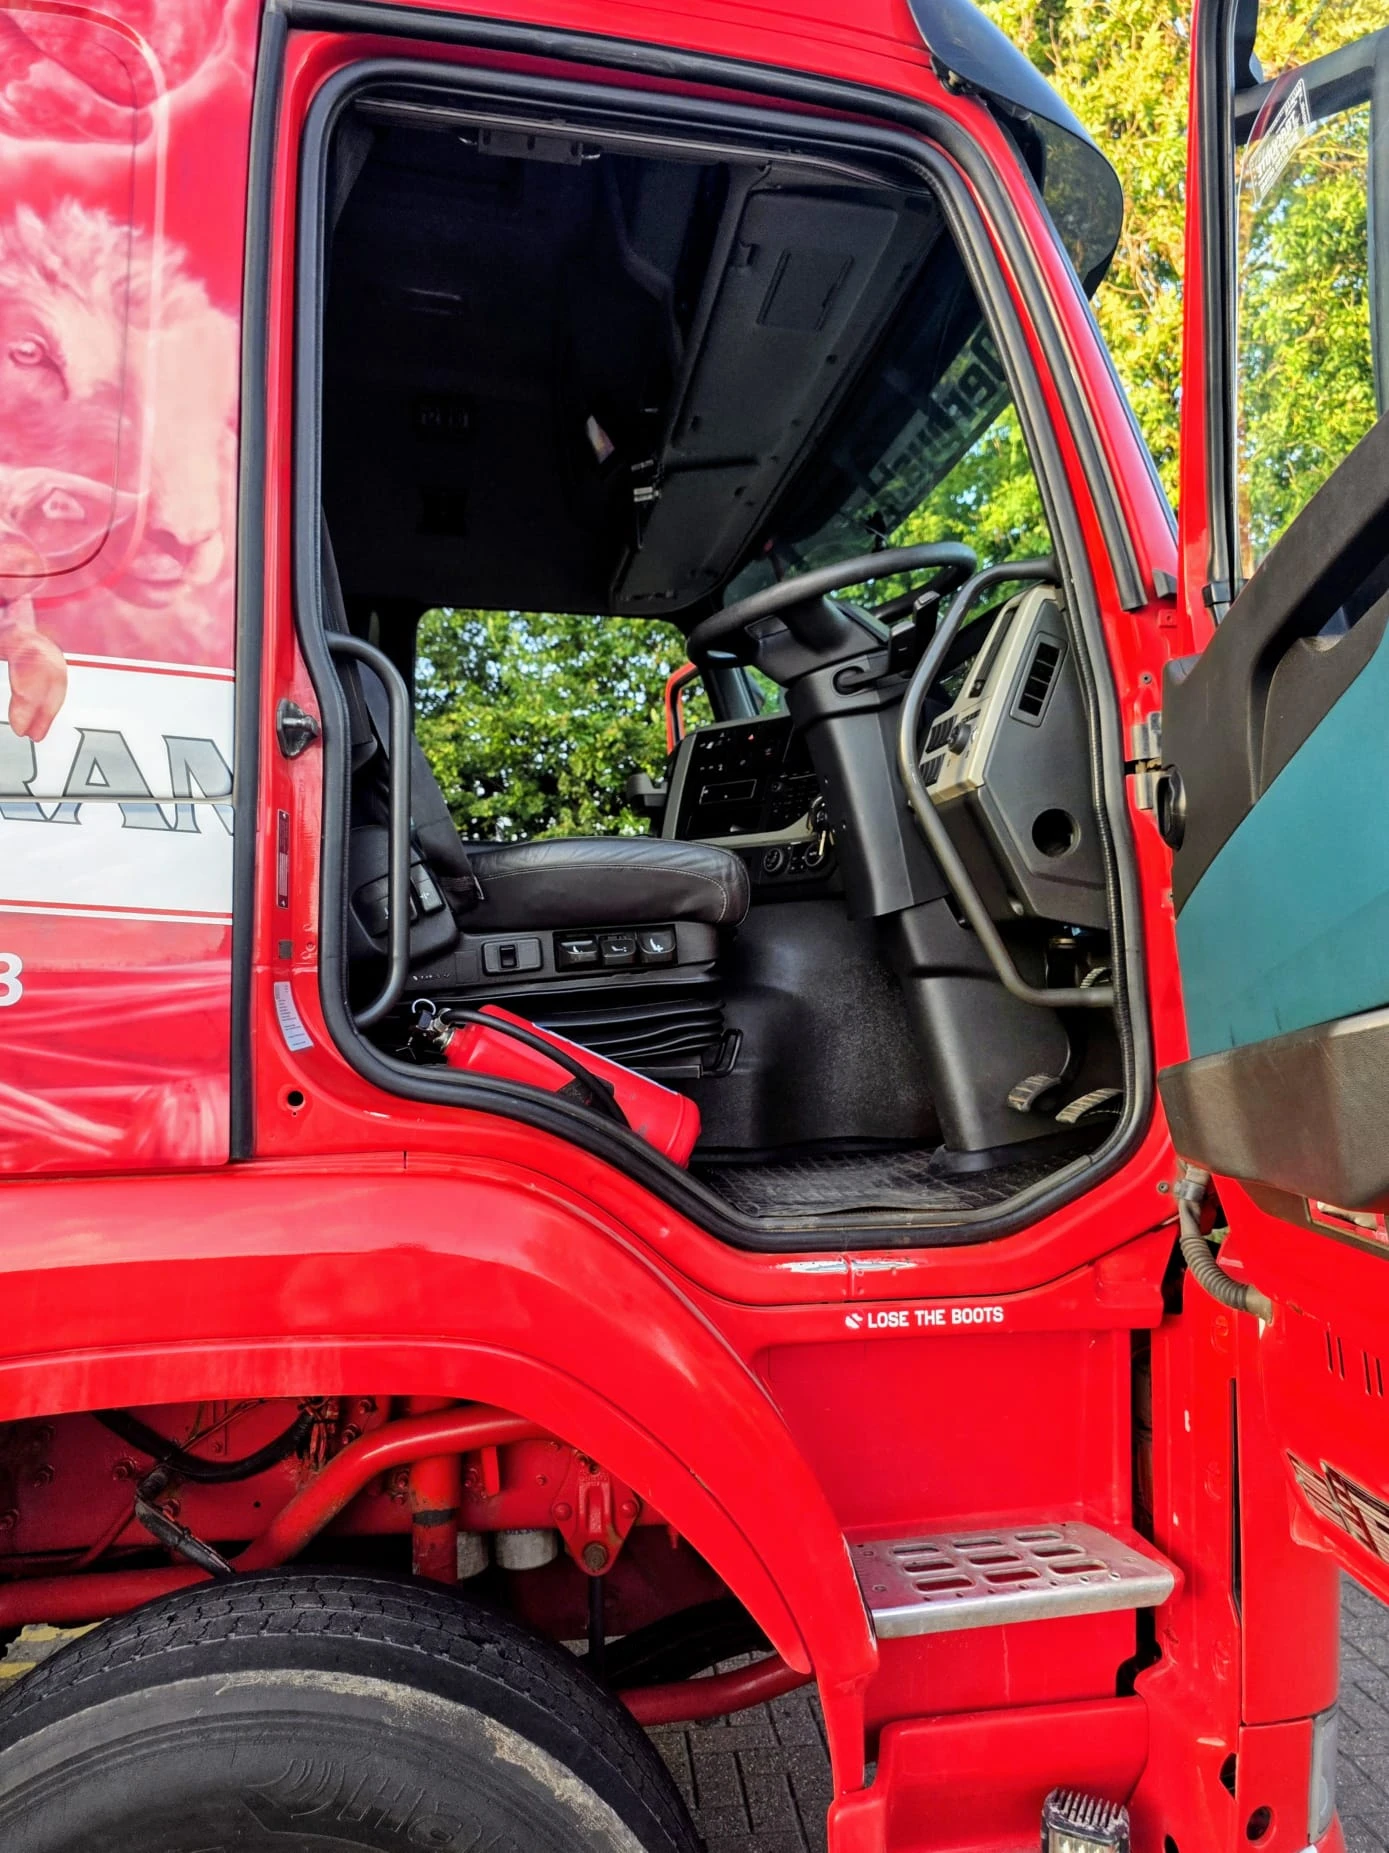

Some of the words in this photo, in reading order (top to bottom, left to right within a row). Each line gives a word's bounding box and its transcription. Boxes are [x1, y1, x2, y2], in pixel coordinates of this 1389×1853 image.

[867, 1311, 909, 1328] LOSE
[915, 1309, 946, 1326] THE
[951, 1306, 1004, 1324] BOOTS
